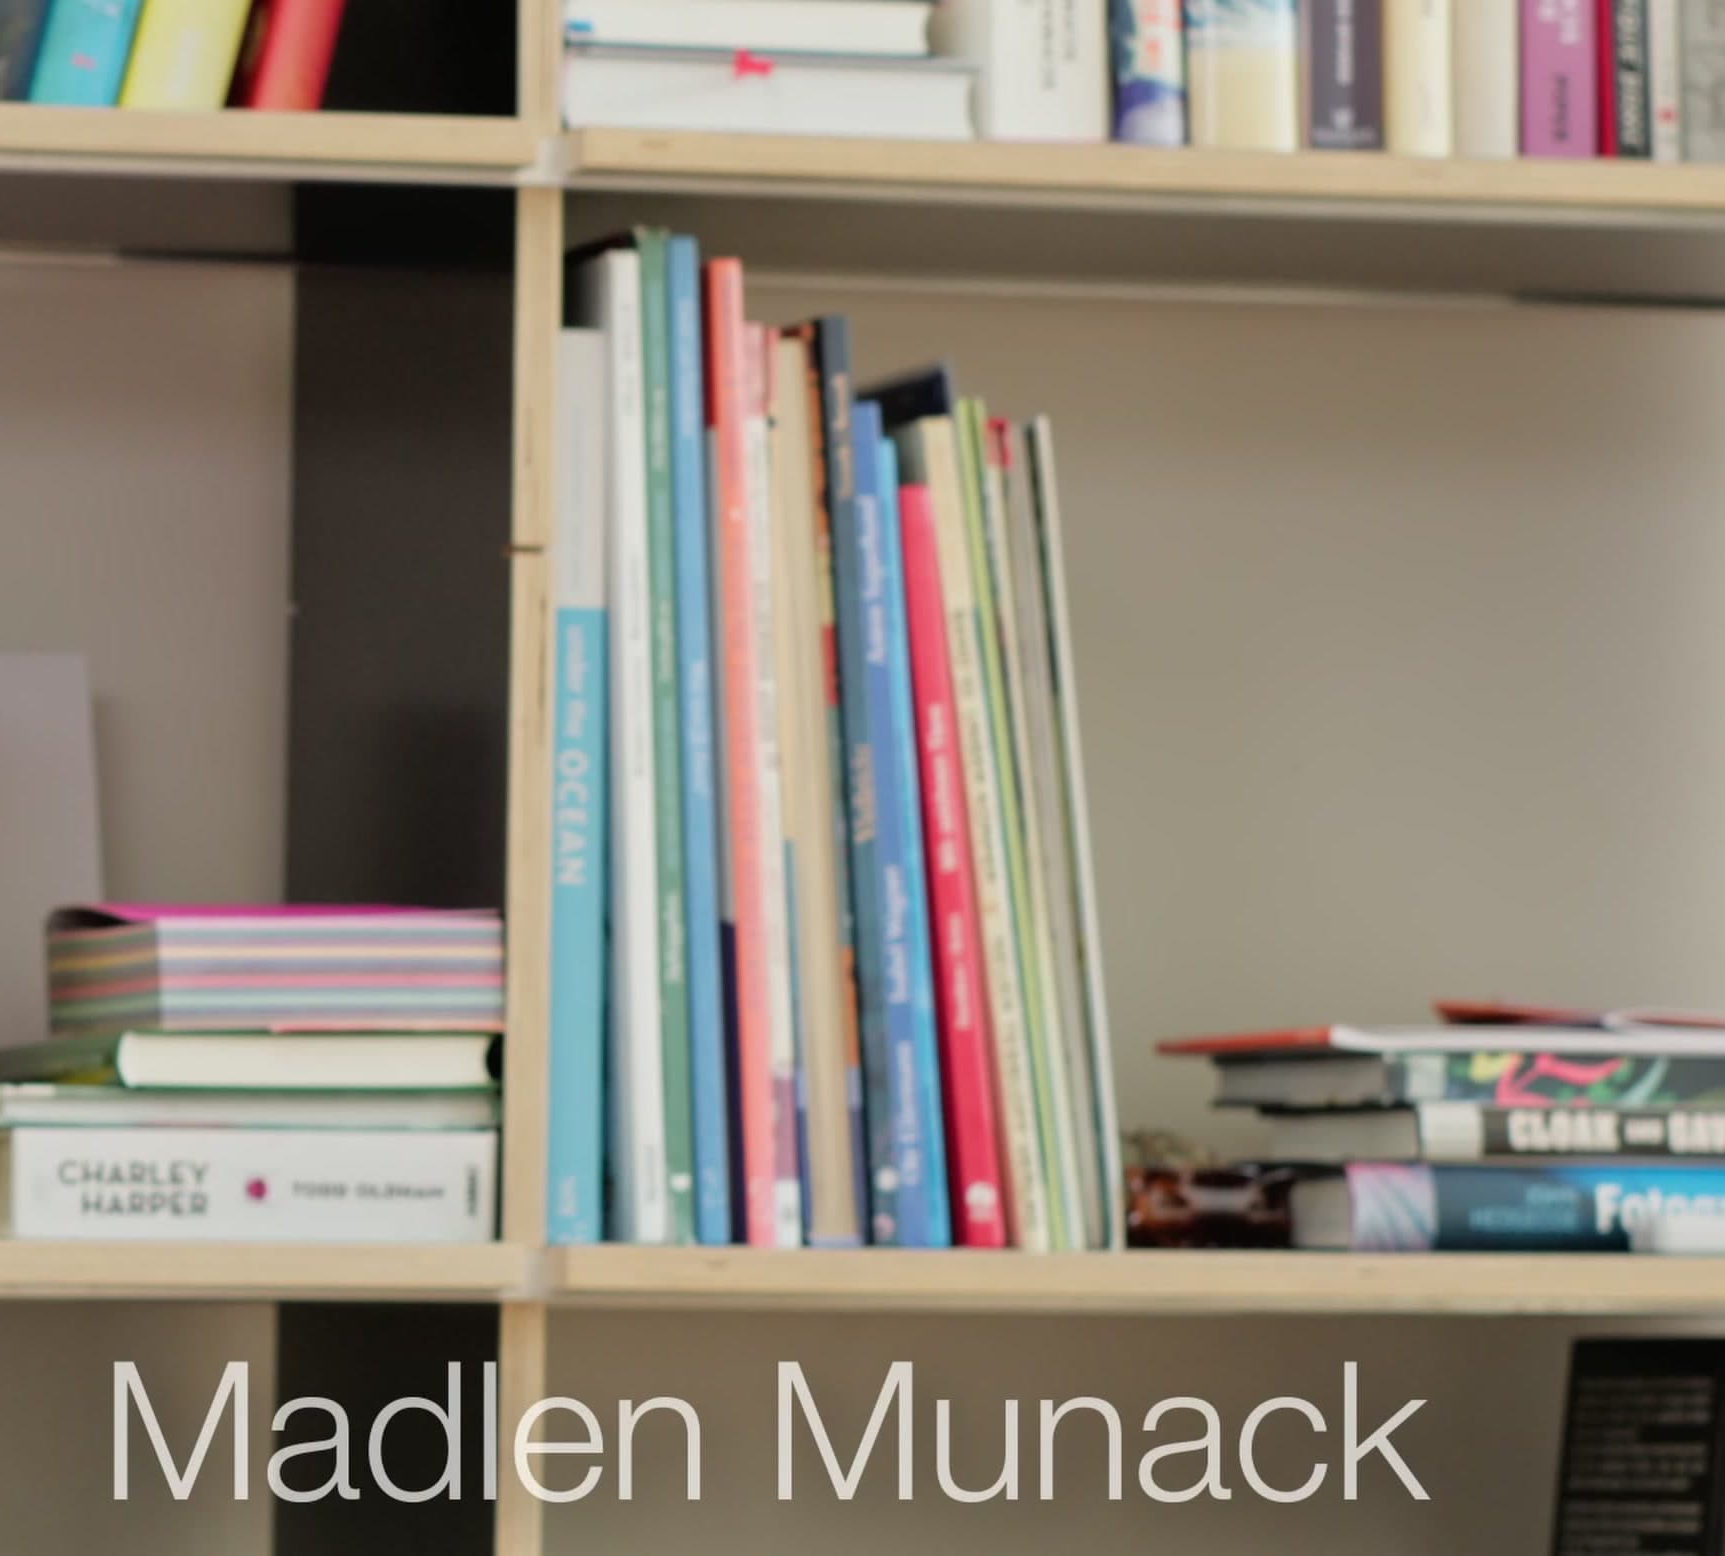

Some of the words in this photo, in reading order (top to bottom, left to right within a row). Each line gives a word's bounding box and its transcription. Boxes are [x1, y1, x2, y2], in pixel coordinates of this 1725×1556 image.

[558, 749, 589, 886] OCEAN
[1507, 1110, 1619, 1152] CLOAK
[57, 1161, 209, 1187] CHARLEY
[81, 1190, 208, 1216] HARPER
